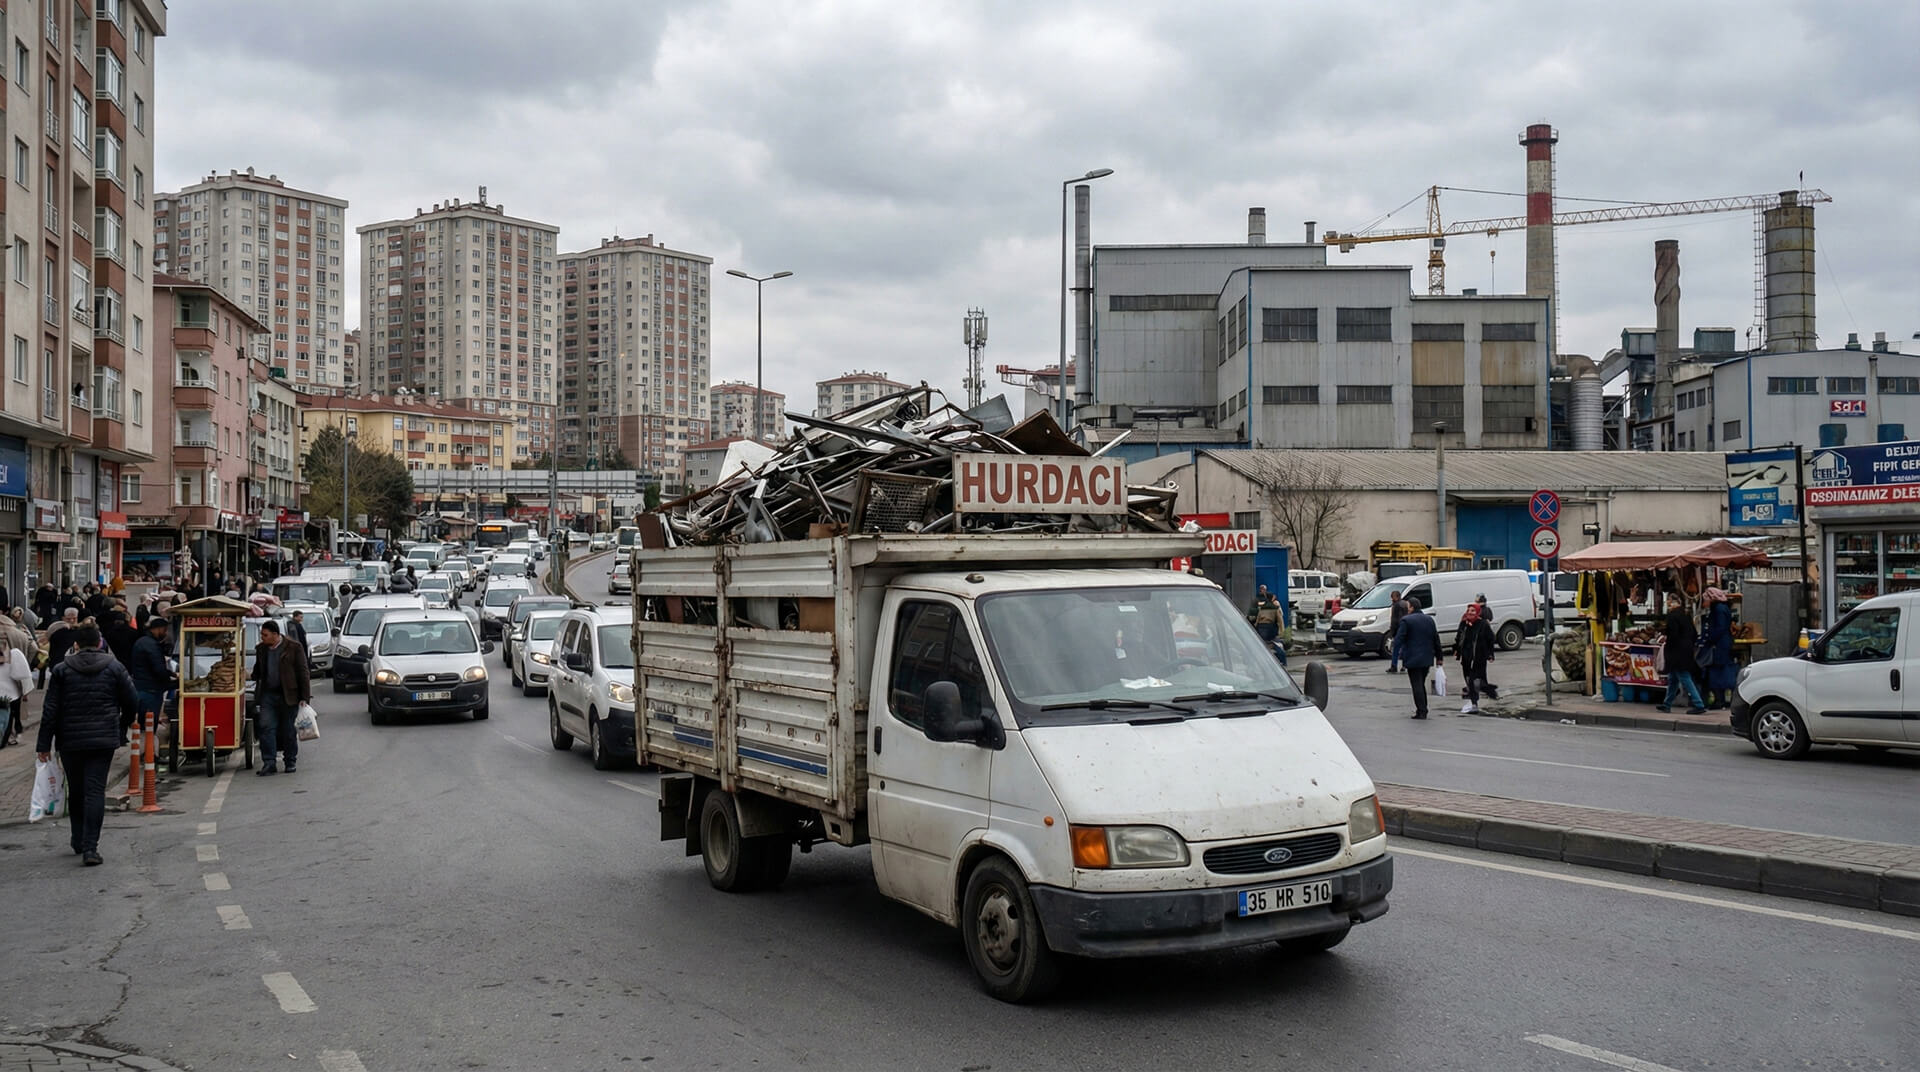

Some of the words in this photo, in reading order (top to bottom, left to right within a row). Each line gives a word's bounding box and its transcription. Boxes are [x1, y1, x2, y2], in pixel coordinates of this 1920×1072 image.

[961, 461, 1122, 506] HURDACI
[1207, 533, 1254, 553] RDACI
[1248, 891, 1267, 912] 35
[1303, 883, 1329, 904] 510
